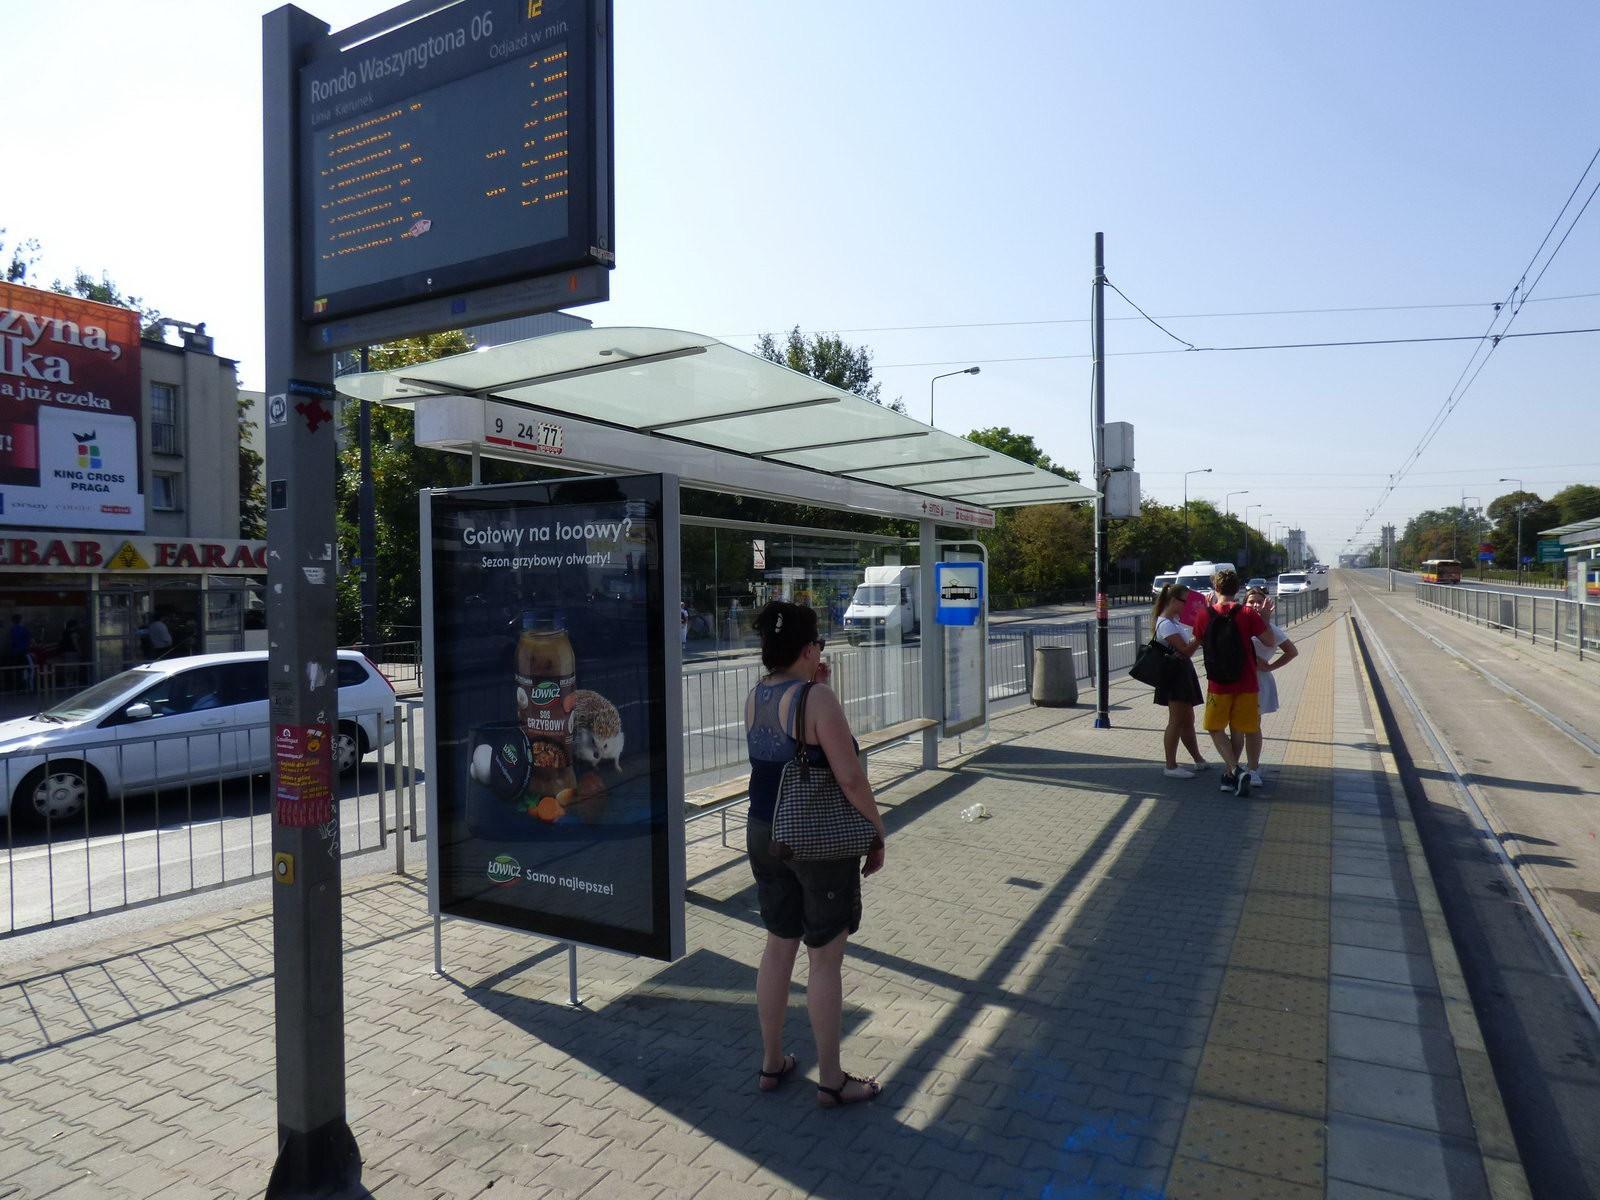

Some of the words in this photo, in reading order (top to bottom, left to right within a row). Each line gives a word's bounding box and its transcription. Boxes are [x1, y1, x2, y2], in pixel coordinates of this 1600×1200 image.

[489, 33, 528, 59] Odjazd
[531, 30, 542, 42] w
[545, 20, 569, 38] min.
[311, 67, 357, 104] Rondo
[359, 27, 465, 84] Waszyngtona
[471, 11, 493, 41] 06
[16, 382, 52, 401] już
[56, 391, 112, 410] czeka
[495, 417, 504, 434] 9
[517, 422, 534, 440] 24
[542, 427, 558, 446] 77
[53, 469, 84, 480] KING
[87, 472, 125, 483] CROSS
[71, 482, 110, 493] PRAGA
[463, 526, 524, 546] Gotowy
[529, 526, 550, 542] na
[555, 518, 632, 543] łooowy?
[481, 556, 511, 568] Sezon
[512, 553, 563, 570] grzybowy
[566, 552, 611, 568] otwarty!
[527, 717, 565, 731] GRZYBOWY
[487, 860, 521, 877] ŁOWICZ
[526, 869, 556, 885] Samo
[559, 876, 614, 896] najlepsze!
